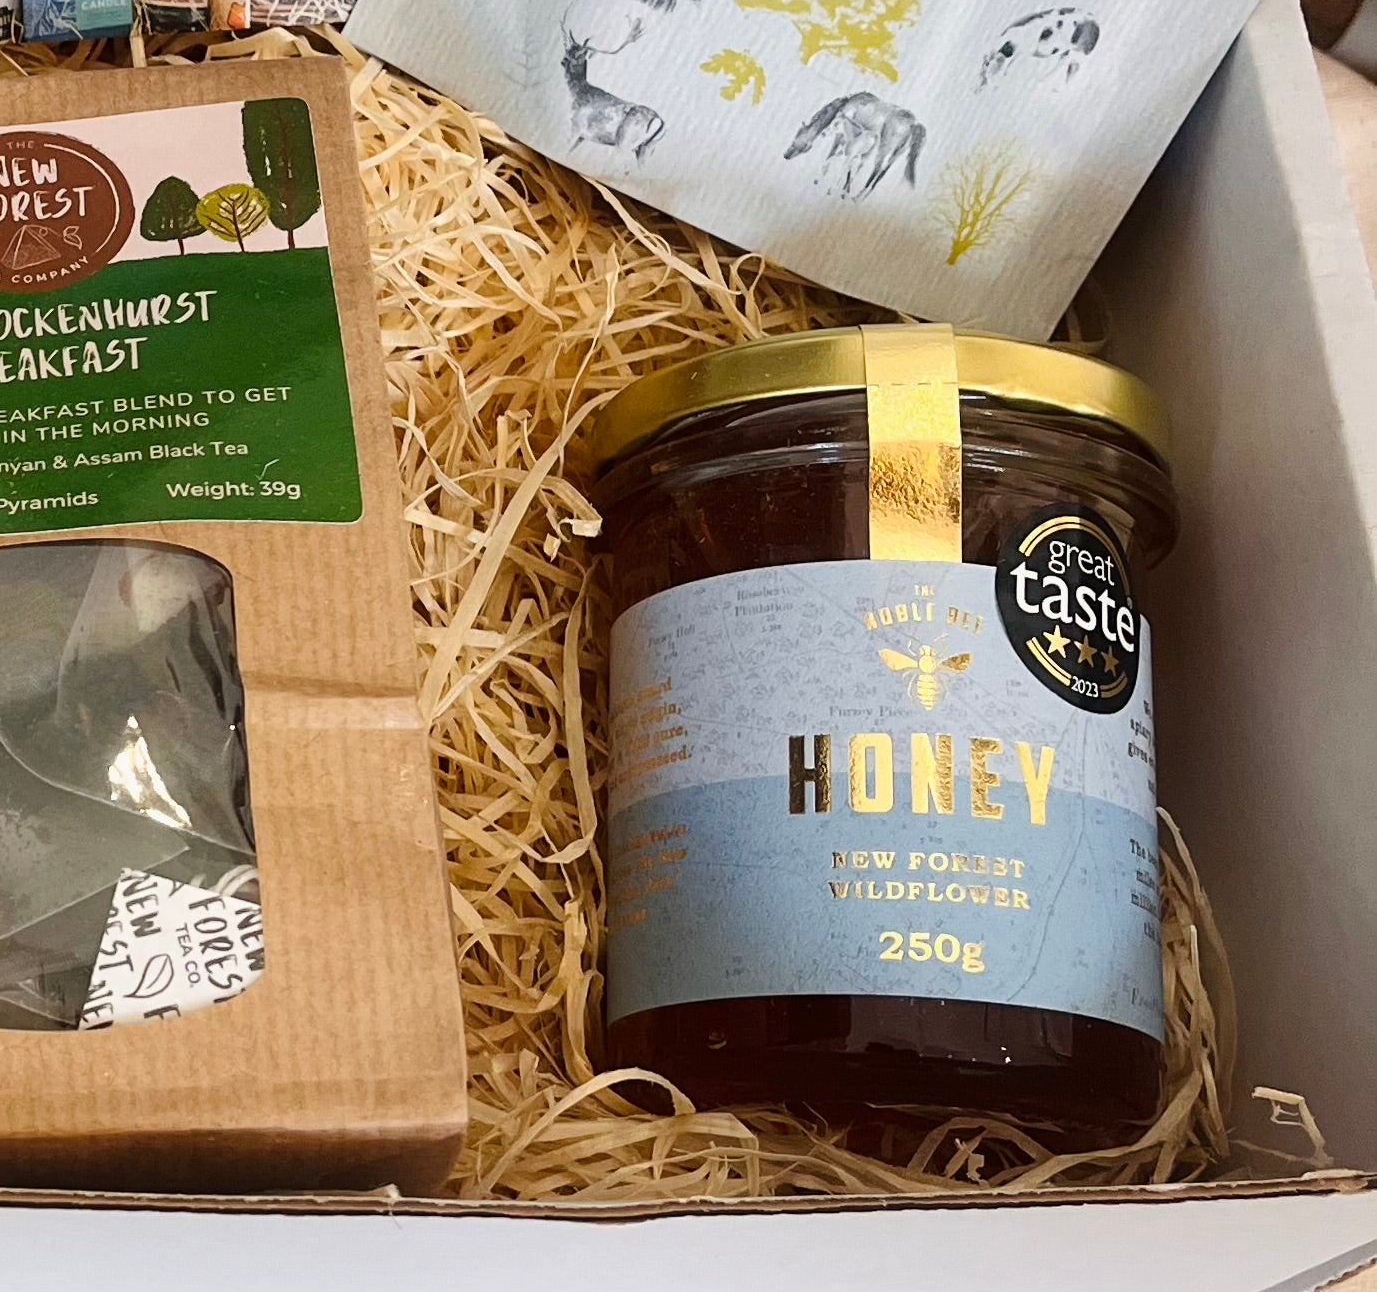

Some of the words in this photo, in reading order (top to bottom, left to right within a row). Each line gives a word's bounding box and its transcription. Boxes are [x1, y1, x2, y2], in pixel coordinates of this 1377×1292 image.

[6, 140, 35, 150] THE
[11, 256, 89, 284] COMPANY
[113, 390, 194, 413] BLEND
[202, 390, 235, 404] TO
[243, 386, 292, 402] GET
[3, 428, 25, 443] IN
[35, 422, 83, 440] THE
[92, 412, 211, 434] MORNING
[53, 454, 67, 469] &
[75, 447, 144, 468] Assam
[149, 440, 205, 460] Black
[211, 440, 249, 456] Tea
[165, 480, 255, 502] Weight:
[259, 480, 302, 500] 39g
[1048, 540, 1115, 586] great
[913, 584, 935, 596] THE
[863, 602, 935, 630] NOBLE
[946, 607, 983, 634] BEE
[1010, 561, 1135, 652] taste
[1071, 675, 1099, 698] 2023
[787, 732, 1055, 826] HONEY
[831, 851, 896, 869] NEW
[908, 852, 1025, 878] FOREST
[122, 876, 162, 938] NEW
[828, 882, 1030, 910] WILDFLOWER
[176, 923, 193, 957] TEA
[185, 960, 201, 988] CO.
[878, 931, 985, 973] 250g
